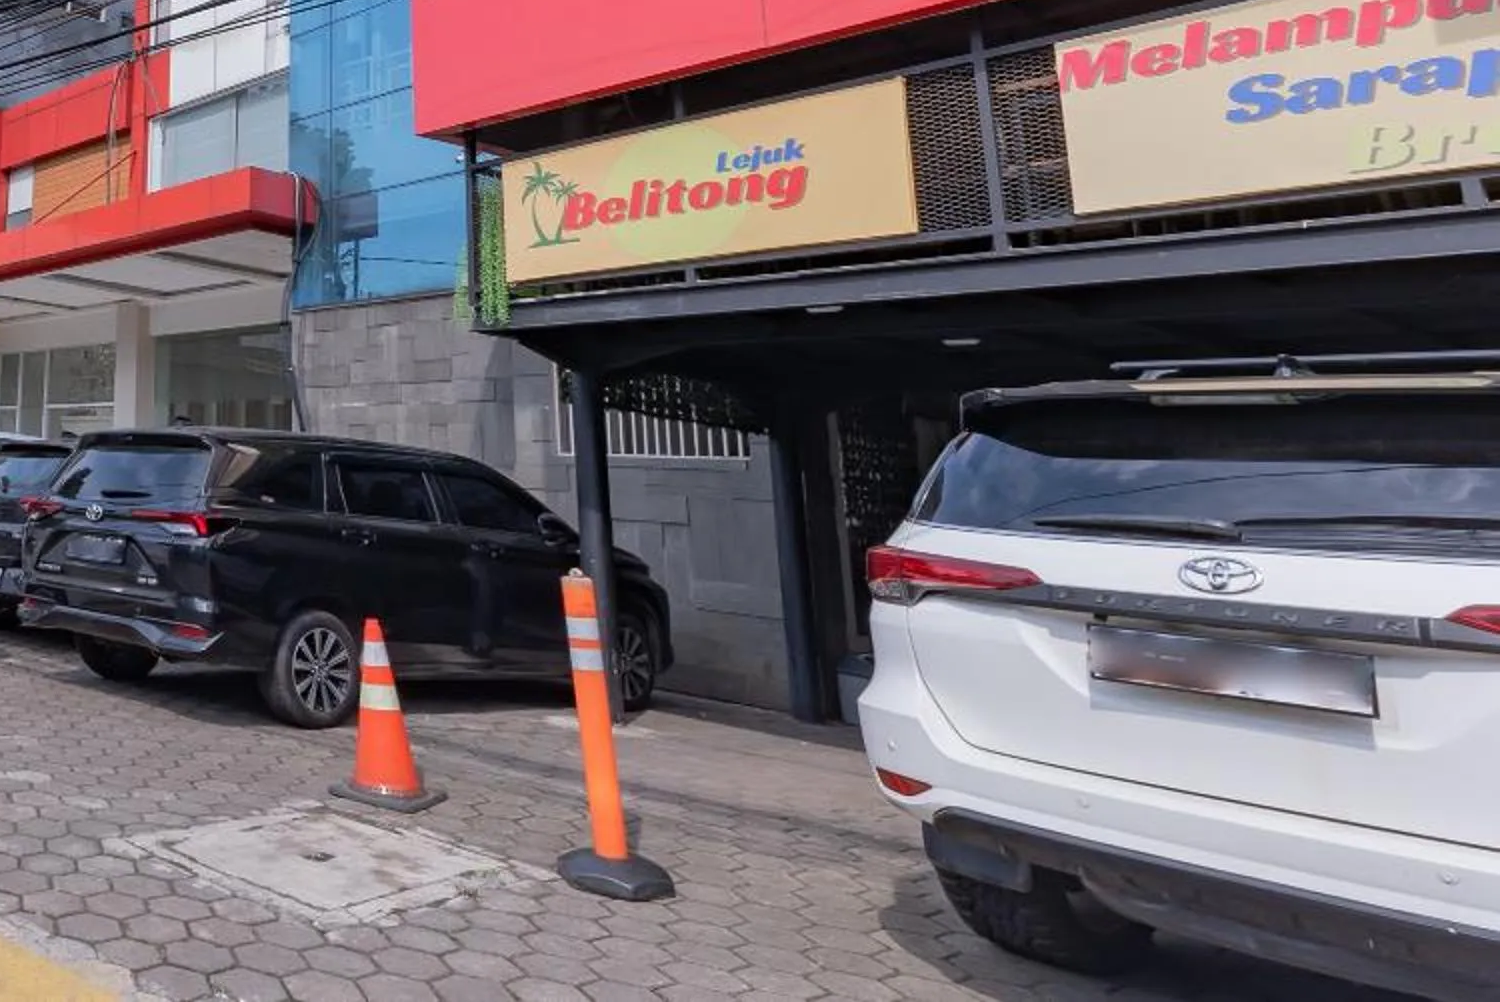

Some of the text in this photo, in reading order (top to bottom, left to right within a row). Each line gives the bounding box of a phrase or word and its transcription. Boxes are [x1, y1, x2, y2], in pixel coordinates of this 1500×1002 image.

[716, 138, 804, 173] Lejuk
[1349, 121, 1500, 175] Br
[562, 165, 809, 231] Belitong
